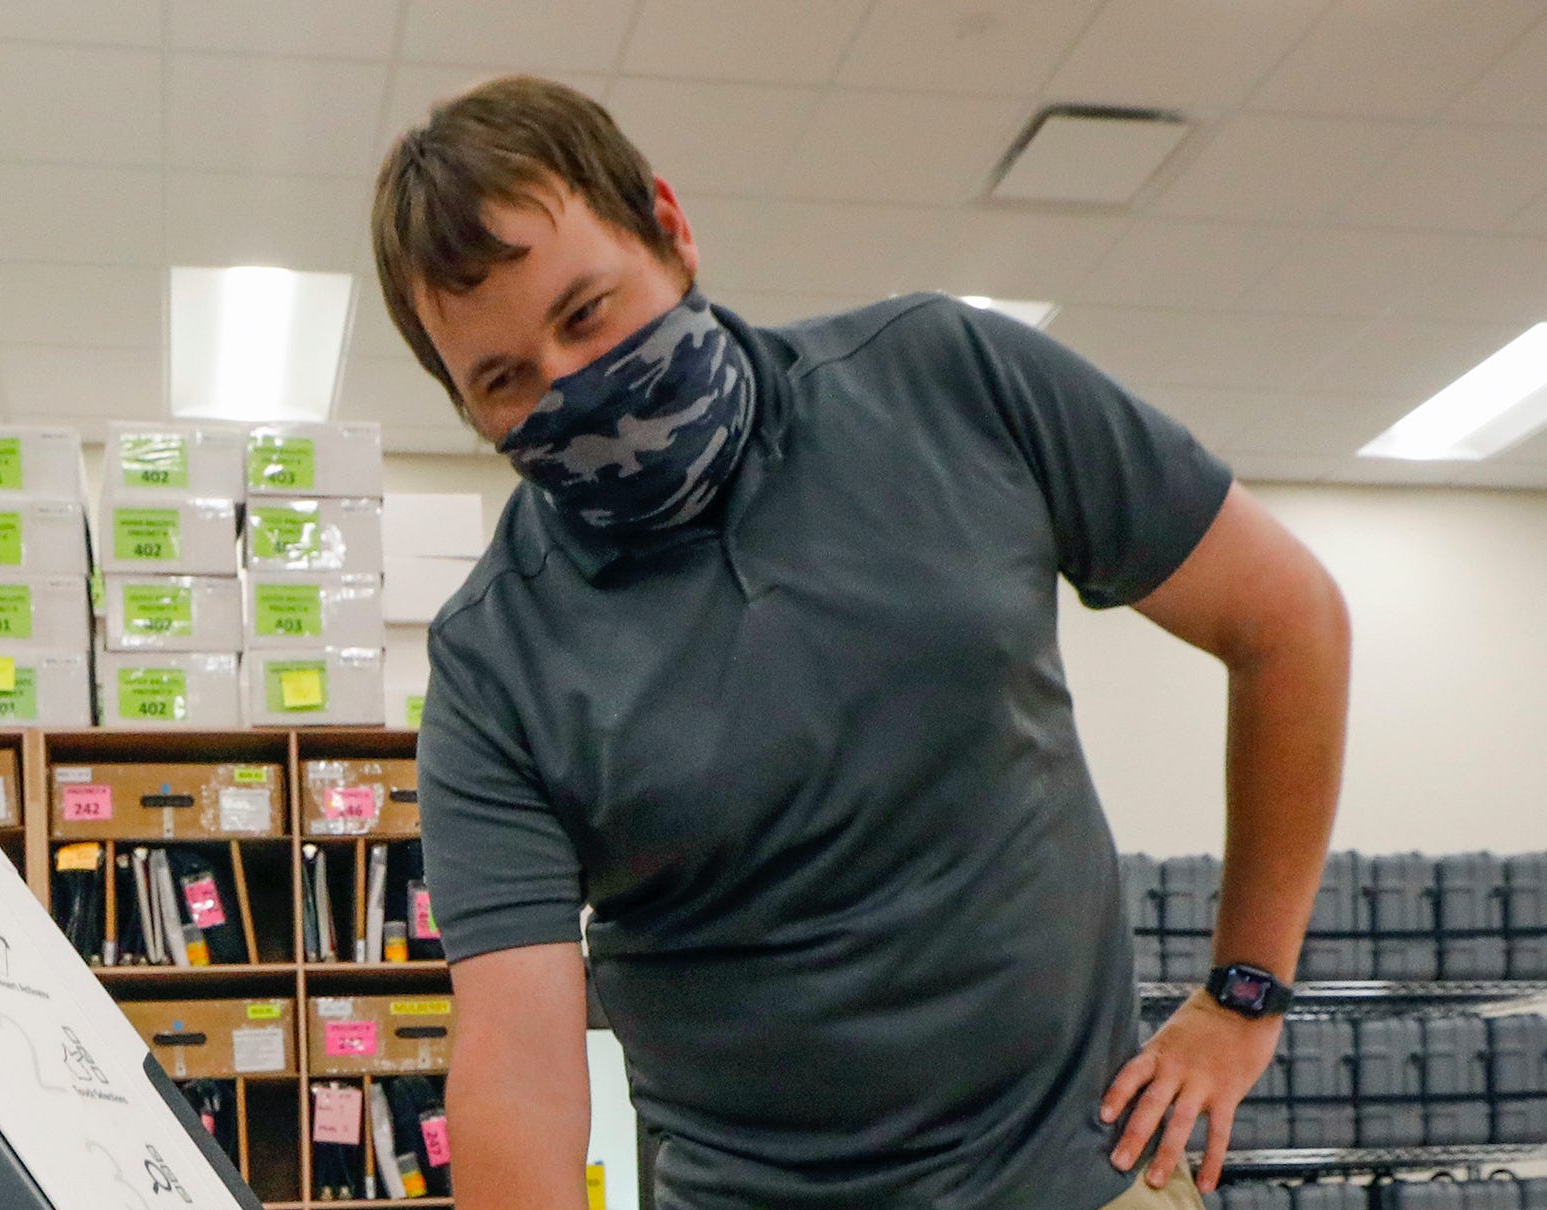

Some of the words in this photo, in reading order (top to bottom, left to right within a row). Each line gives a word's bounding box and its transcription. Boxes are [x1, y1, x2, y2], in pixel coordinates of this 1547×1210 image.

[141, 470, 169, 484] 402
[134, 543, 162, 557] 402
[139, 702, 167, 716] 402
[74, 803, 100, 816] 242
